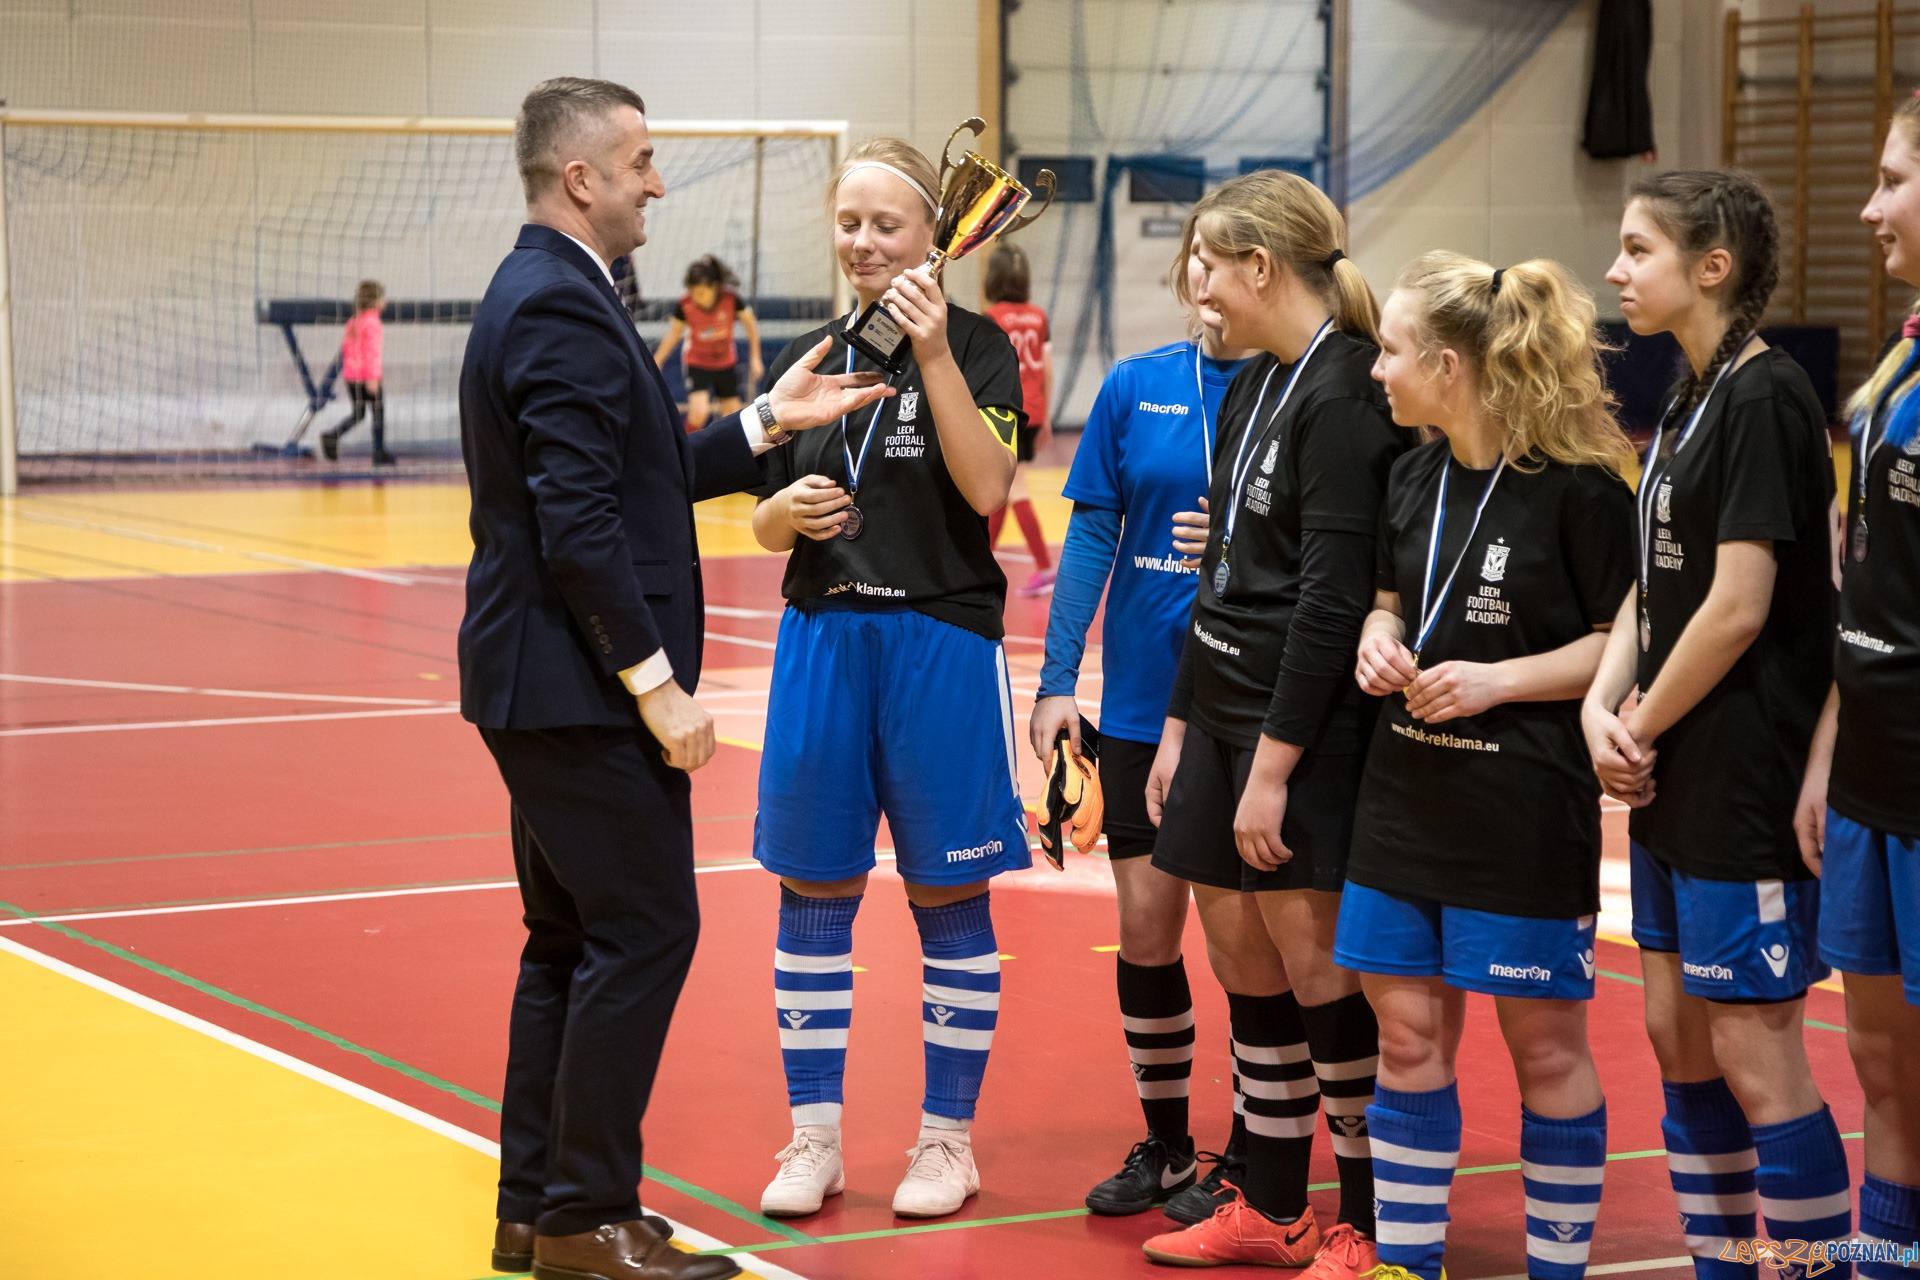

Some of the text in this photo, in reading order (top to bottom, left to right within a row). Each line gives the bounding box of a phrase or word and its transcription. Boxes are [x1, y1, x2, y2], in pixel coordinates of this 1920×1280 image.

[1139, 401, 1189, 415] macron
[897, 425, 915, 435] LECH
[885, 435, 926, 446] FOOTBALL
[884, 446, 925, 458] ACADEMY
[1254, 476, 1270, 490] LECH
[1246, 483, 1272, 505] FOOTBALL
[1479, 585, 1501, 598] LECH
[1467, 595, 1512, 614] FOOTBALL
[1465, 609, 1511, 626] ACADEMY
[1391, 722, 1500, 752] www.druk-reklama.eu
[946, 840, 1003, 863] macron
[1489, 963, 1551, 981] macron
[1683, 961, 1733, 980] macron
